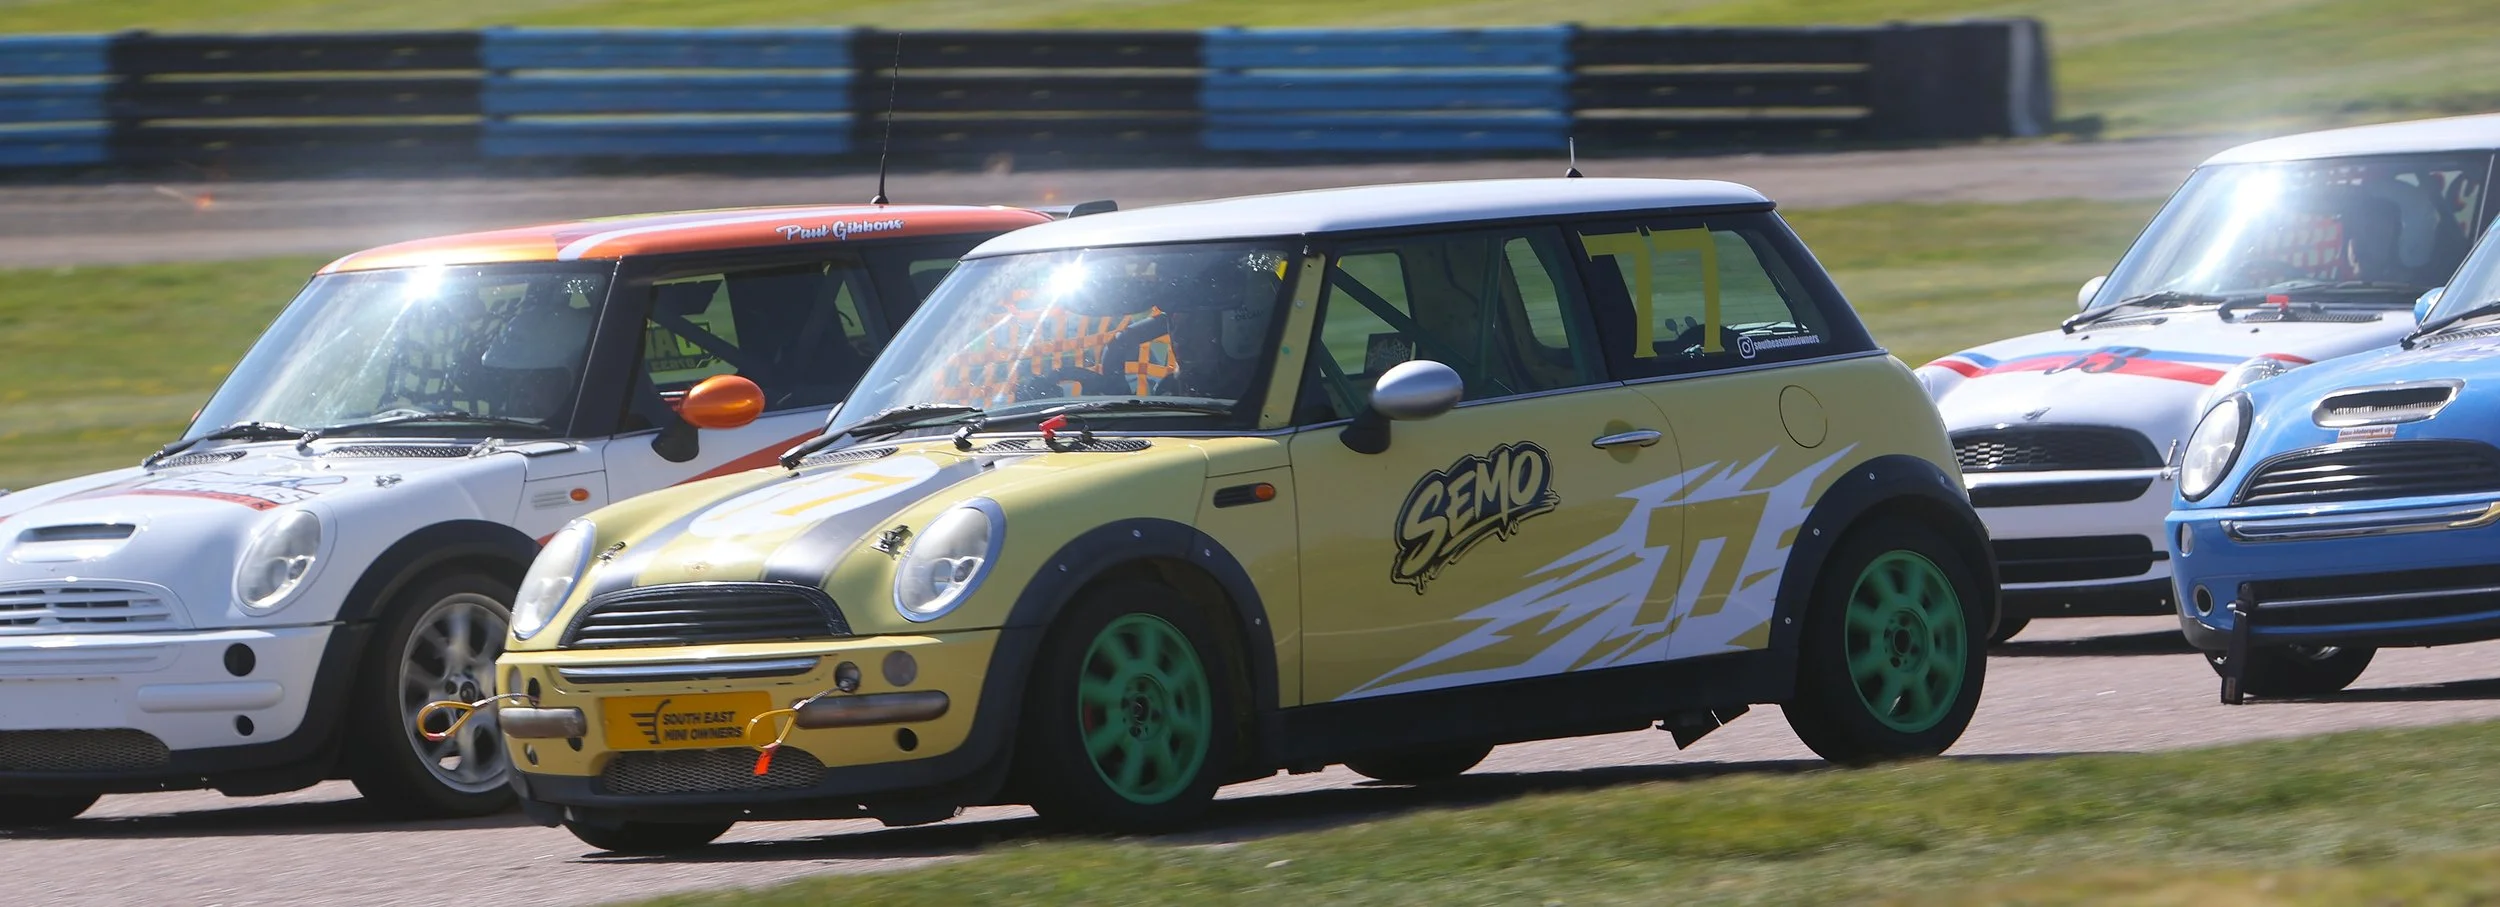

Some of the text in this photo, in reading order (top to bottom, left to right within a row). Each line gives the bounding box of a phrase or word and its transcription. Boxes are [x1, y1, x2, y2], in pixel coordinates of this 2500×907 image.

[776, 219, 904, 241] Paul Gibbons
[1577, 222, 1726, 358] 77
[1753, 334, 1820, 351] southeastminiowners
[1395, 444, 1550, 581] SEMO
[1631, 491, 1771, 627] 77
[663, 710, 736, 726] SOUTH EAST
[664, 726, 743, 742] MINI OWNERS
